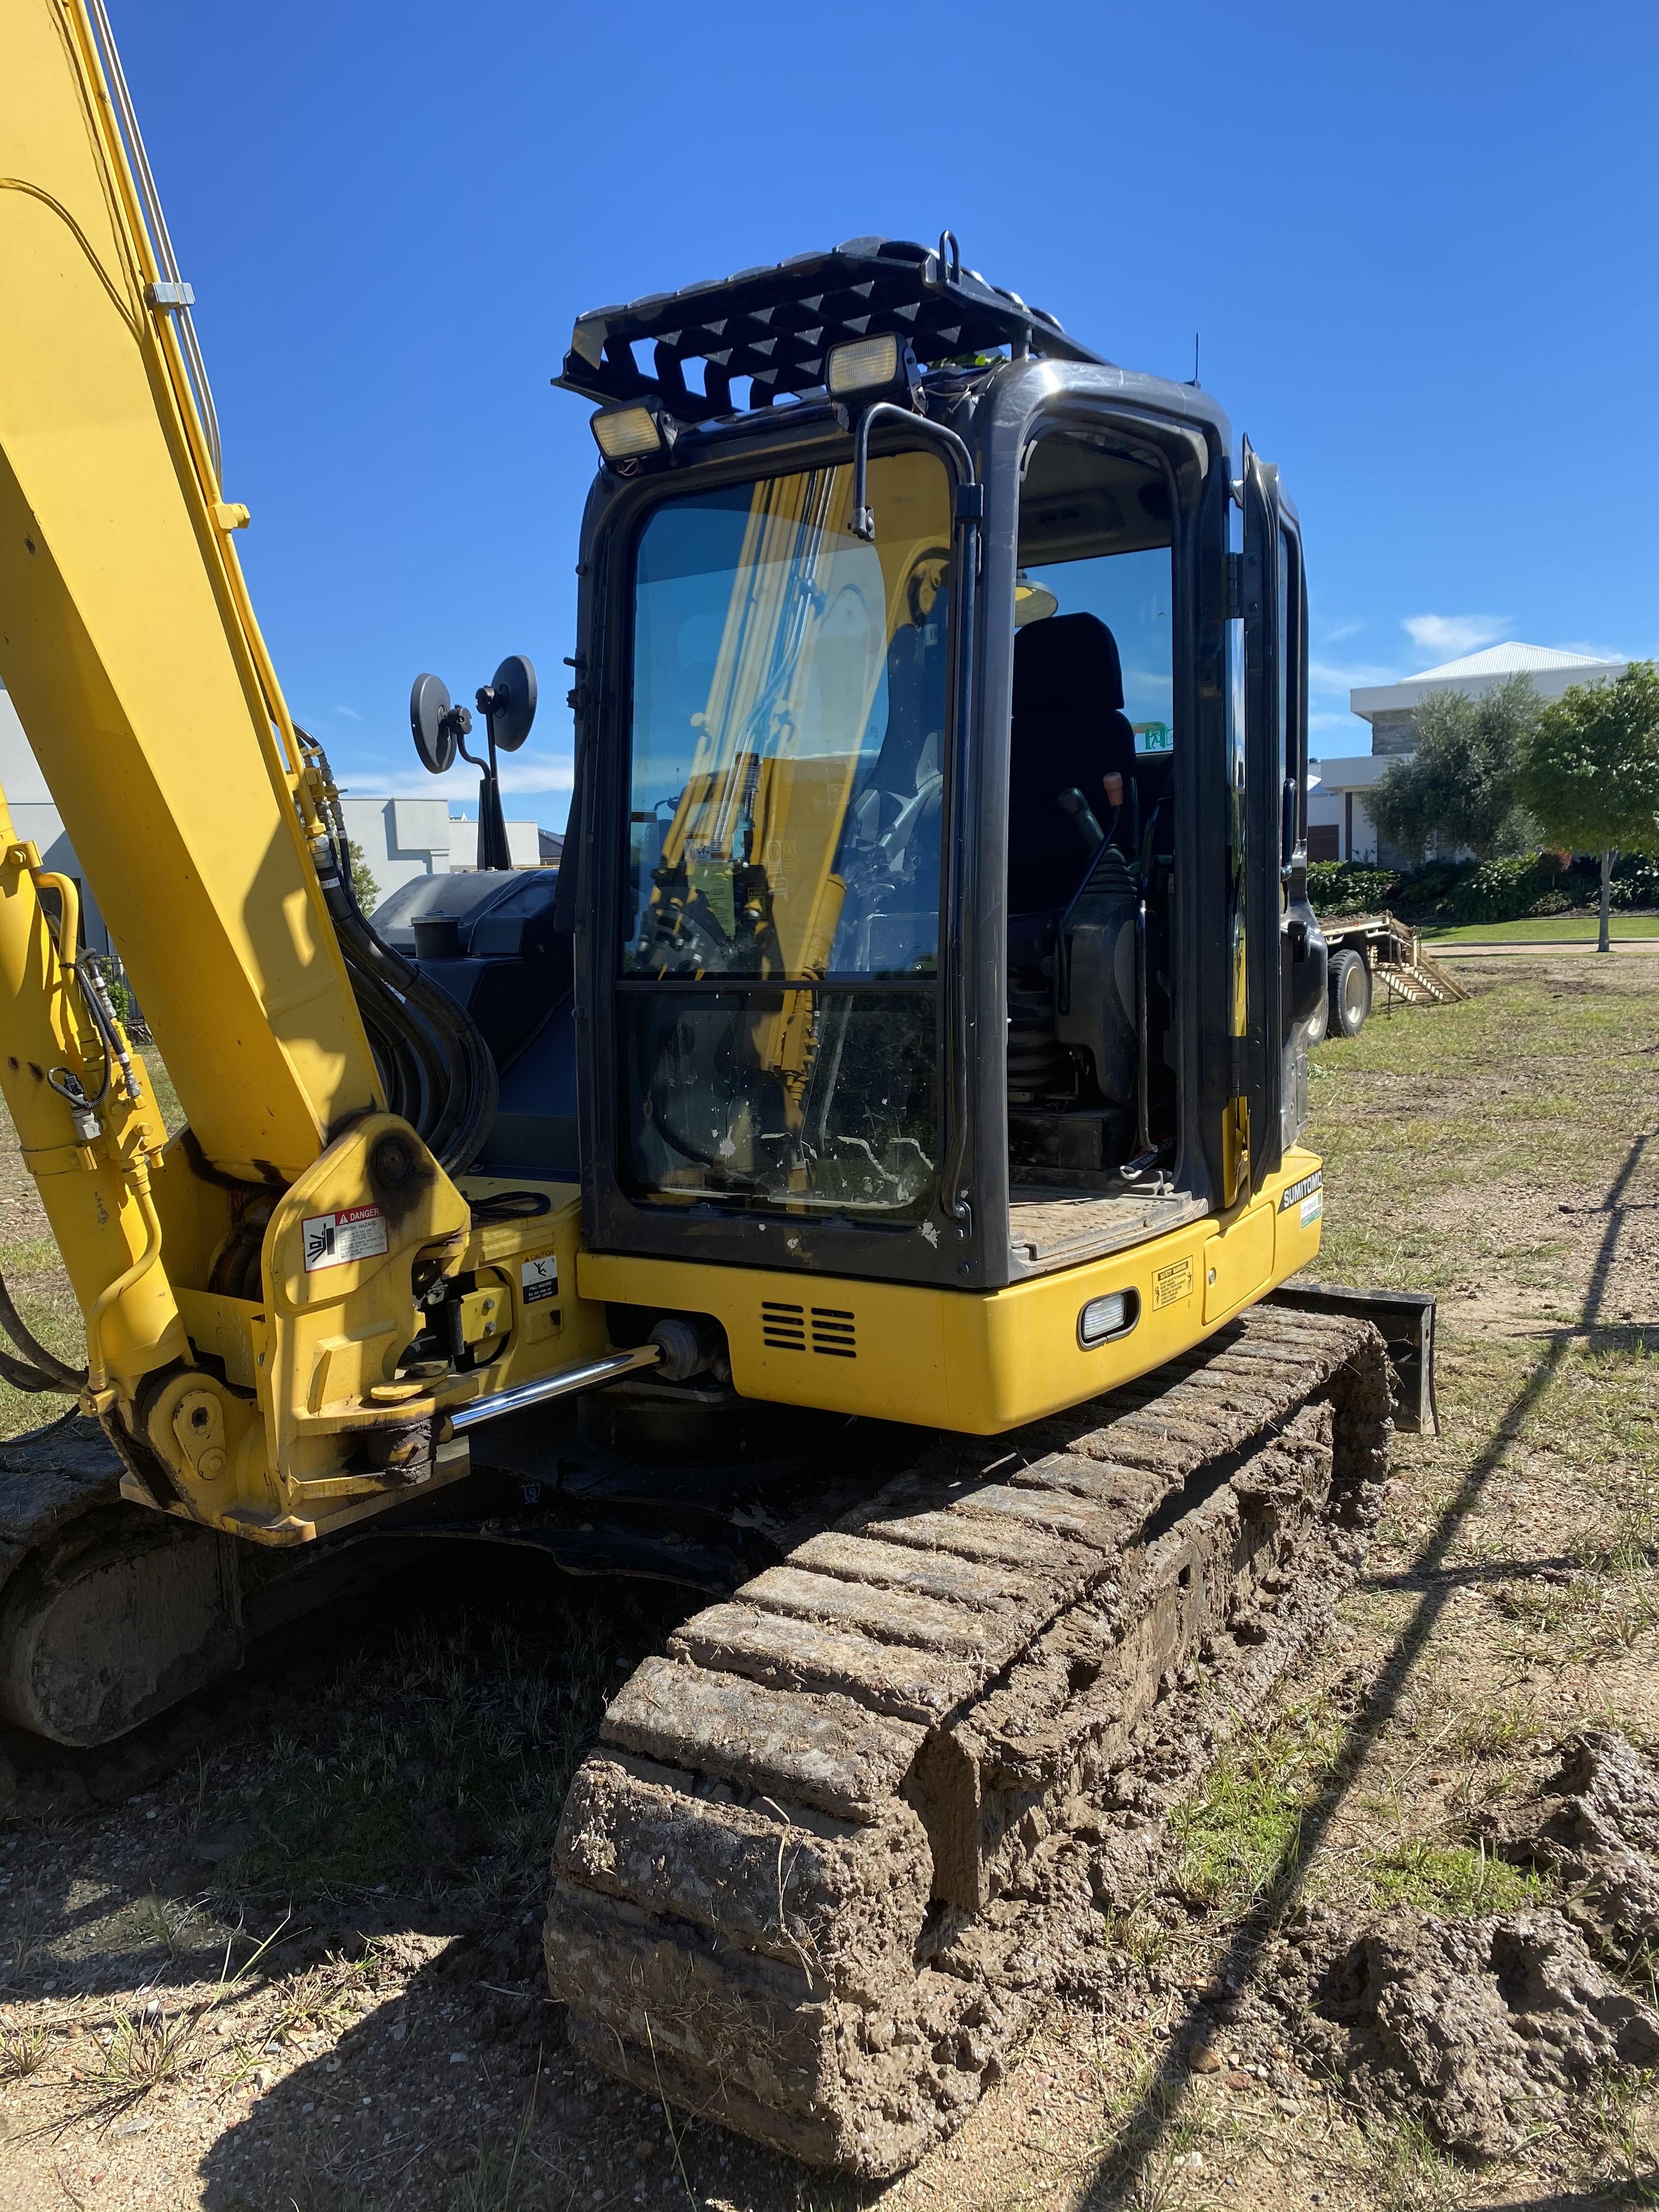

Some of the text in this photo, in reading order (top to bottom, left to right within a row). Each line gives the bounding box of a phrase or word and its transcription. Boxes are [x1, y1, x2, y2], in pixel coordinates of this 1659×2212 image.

[1284, 1170, 1322, 1207] SUMITOMO
[350, 1208, 379, 1221] DANGER
[531, 1250, 554, 1260] CAUTION
[1160, 1269, 1172, 1279] SAFETY
